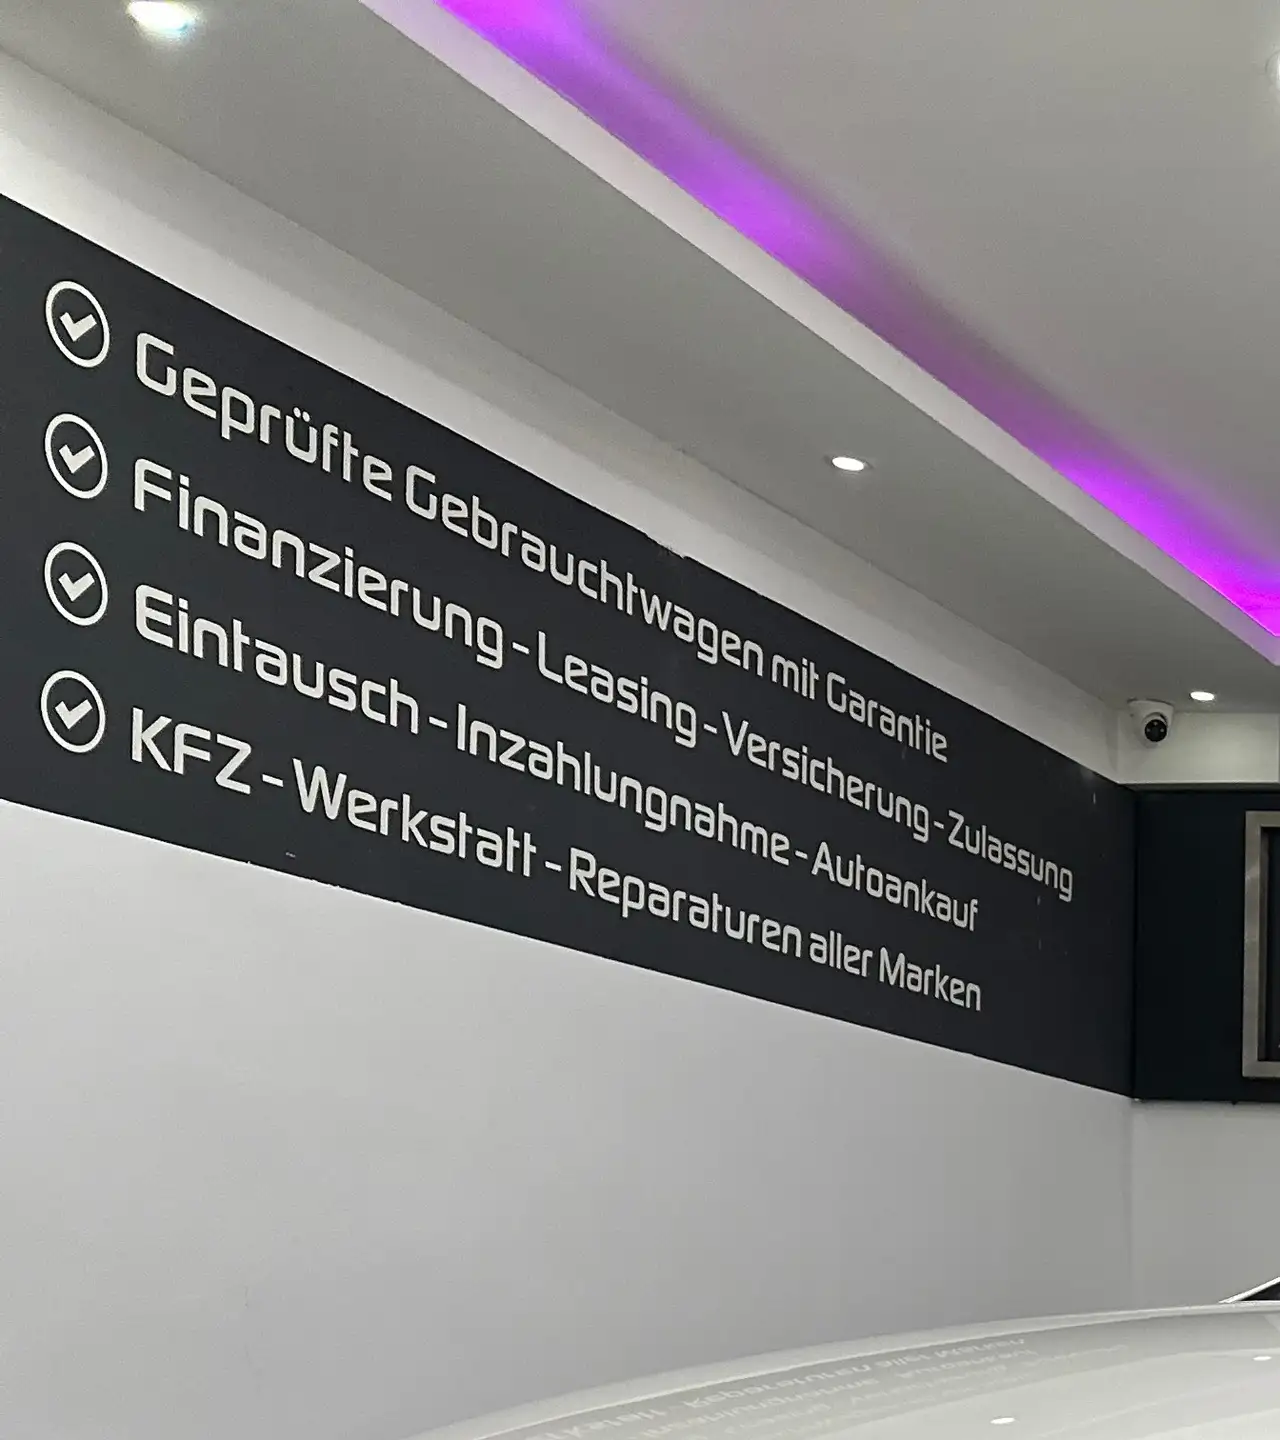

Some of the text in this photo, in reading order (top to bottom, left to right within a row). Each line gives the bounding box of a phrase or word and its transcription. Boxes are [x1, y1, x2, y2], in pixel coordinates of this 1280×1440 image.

[134, 458, 504, 670] Finanzierung
[538, 630, 697, 749] Leasing
[721, 710, 929, 843] Versicherung
[948, 810, 1073, 903] Zulassung
[136, 332, 948, 763] Geprüfte Gebrauchtwagen mit Garantie
[131, 707, 252, 795] KFZ
[292, 757, 537, 878] Werkstatt
[569, 847, 802, 958] Reparaturen
[809, 930, 874, 978] aller
[879, 946, 981, 1011] Marken
[135, 584, 419, 735] Eintausch
[457, 703, 790, 866] Inzahlungnahme
[811, 841, 978, 932] Autoankauf
